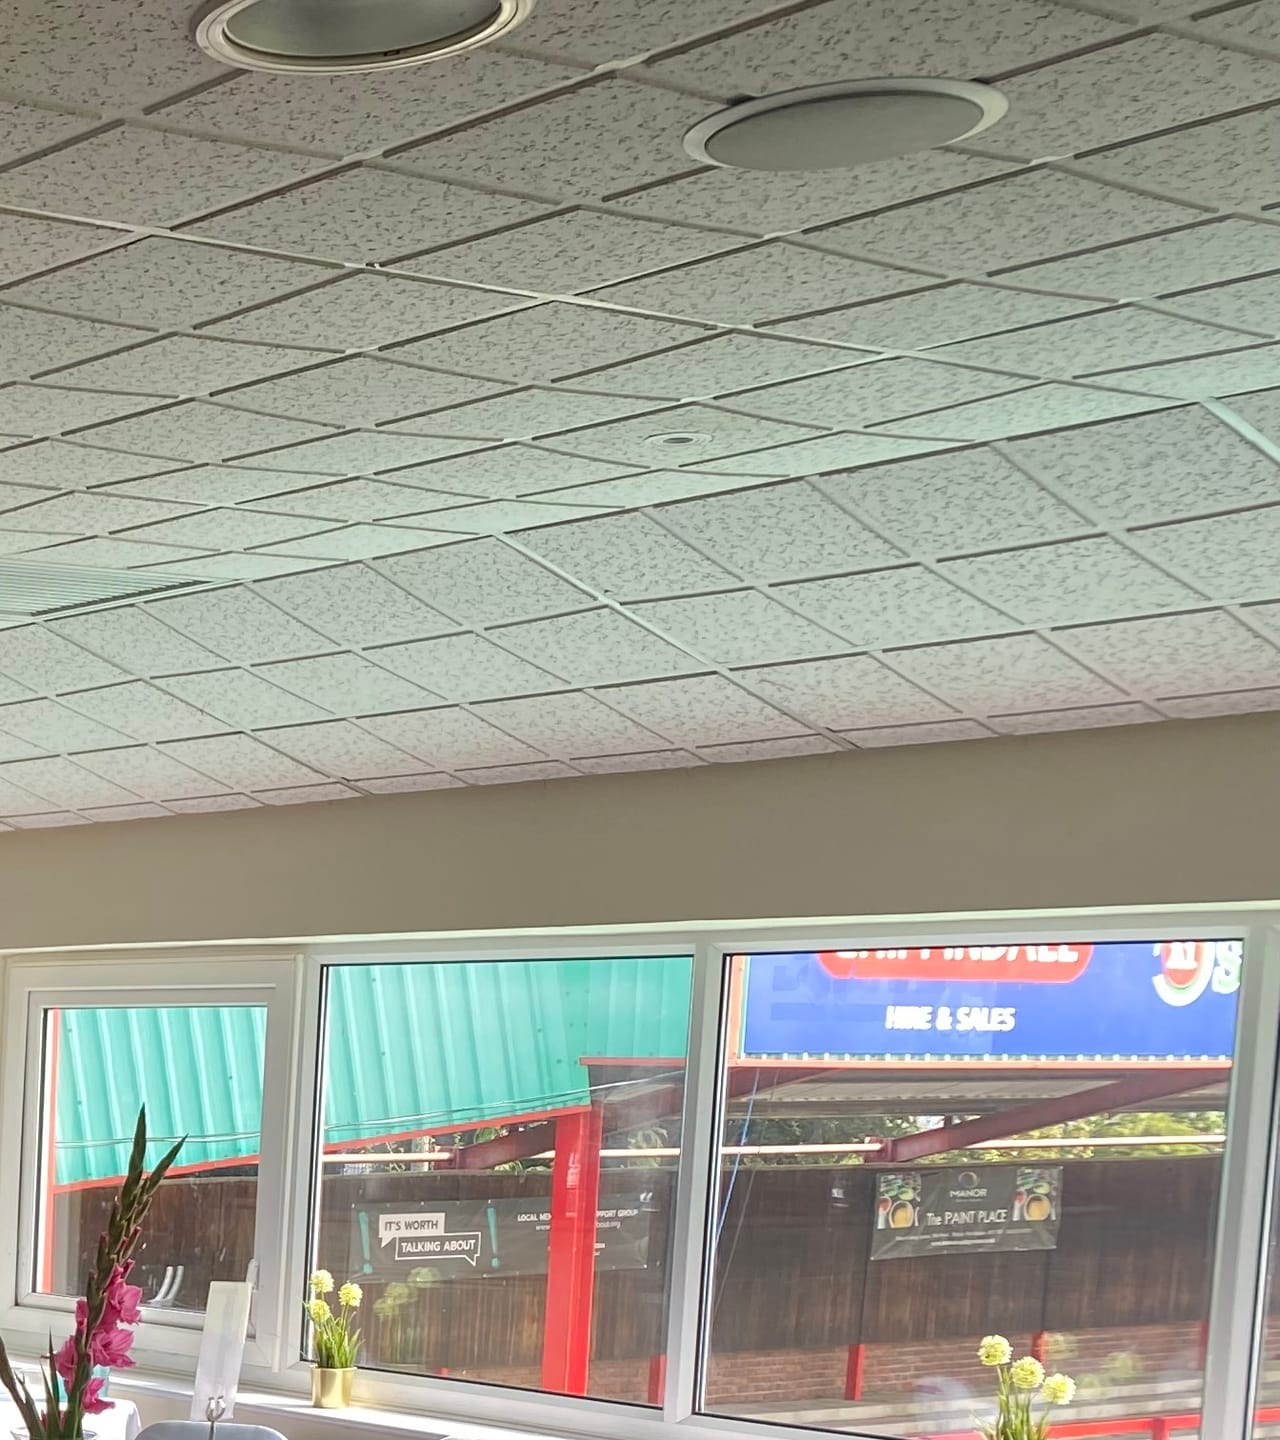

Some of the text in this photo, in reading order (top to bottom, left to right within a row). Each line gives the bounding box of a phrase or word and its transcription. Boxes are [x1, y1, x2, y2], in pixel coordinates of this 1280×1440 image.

[885, 1005, 1016, 1032] HIRE & SALES
[517, 1213, 539, 1222] LOCAL
[977, 1209, 1009, 1223] PLACE
[384, 1220, 439, 1232] IT'S WORTH
[401, 1239, 476, 1253] TALKING ABOUT
